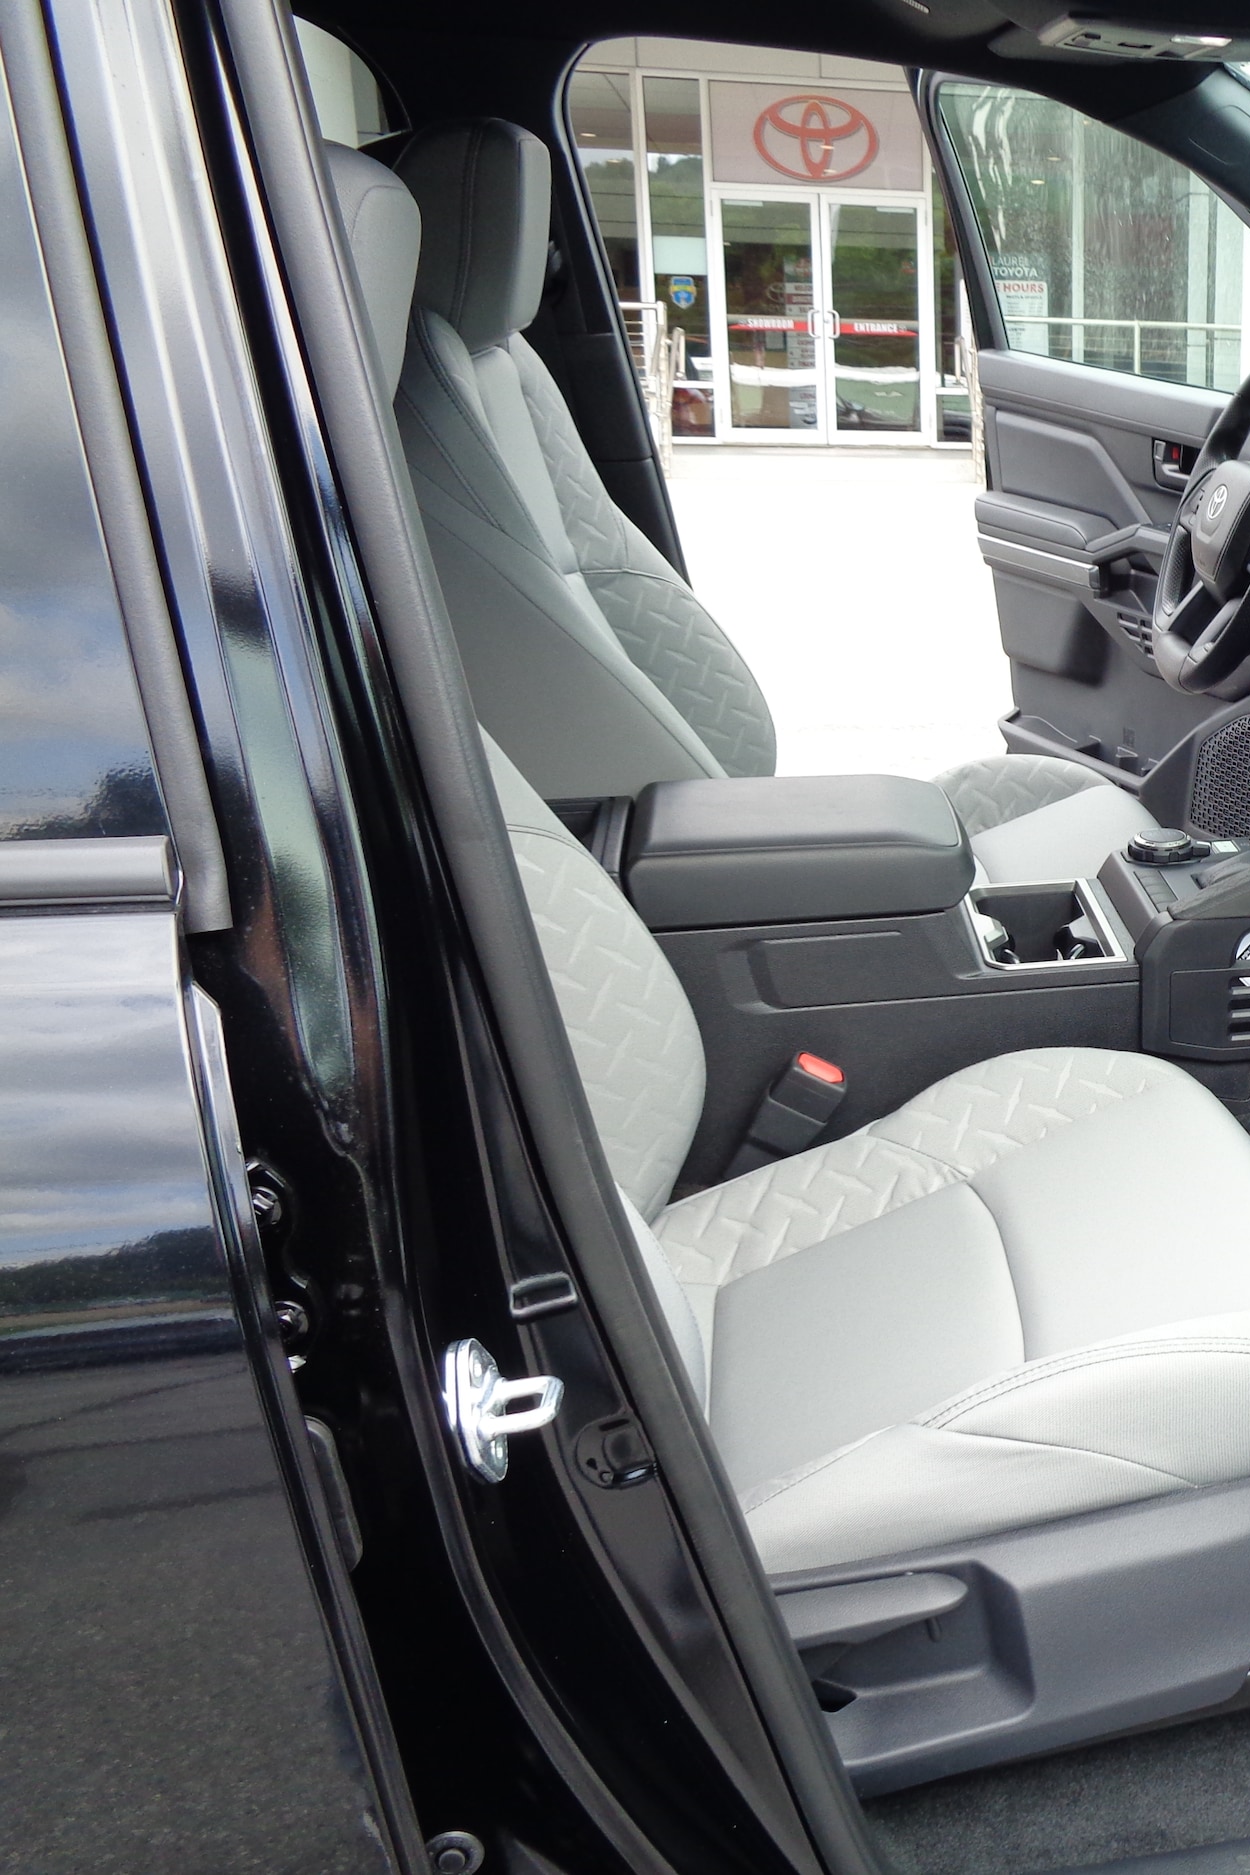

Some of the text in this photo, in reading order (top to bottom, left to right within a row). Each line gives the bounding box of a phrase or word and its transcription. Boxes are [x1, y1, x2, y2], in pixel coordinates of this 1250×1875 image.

[993, 266, 1038, 277] TOYOTA
[1003, 282, 1044, 293] HOURS
[747, 318, 795, 330] SHOWROOM
[854, 323, 899, 334] ENTRANCE
